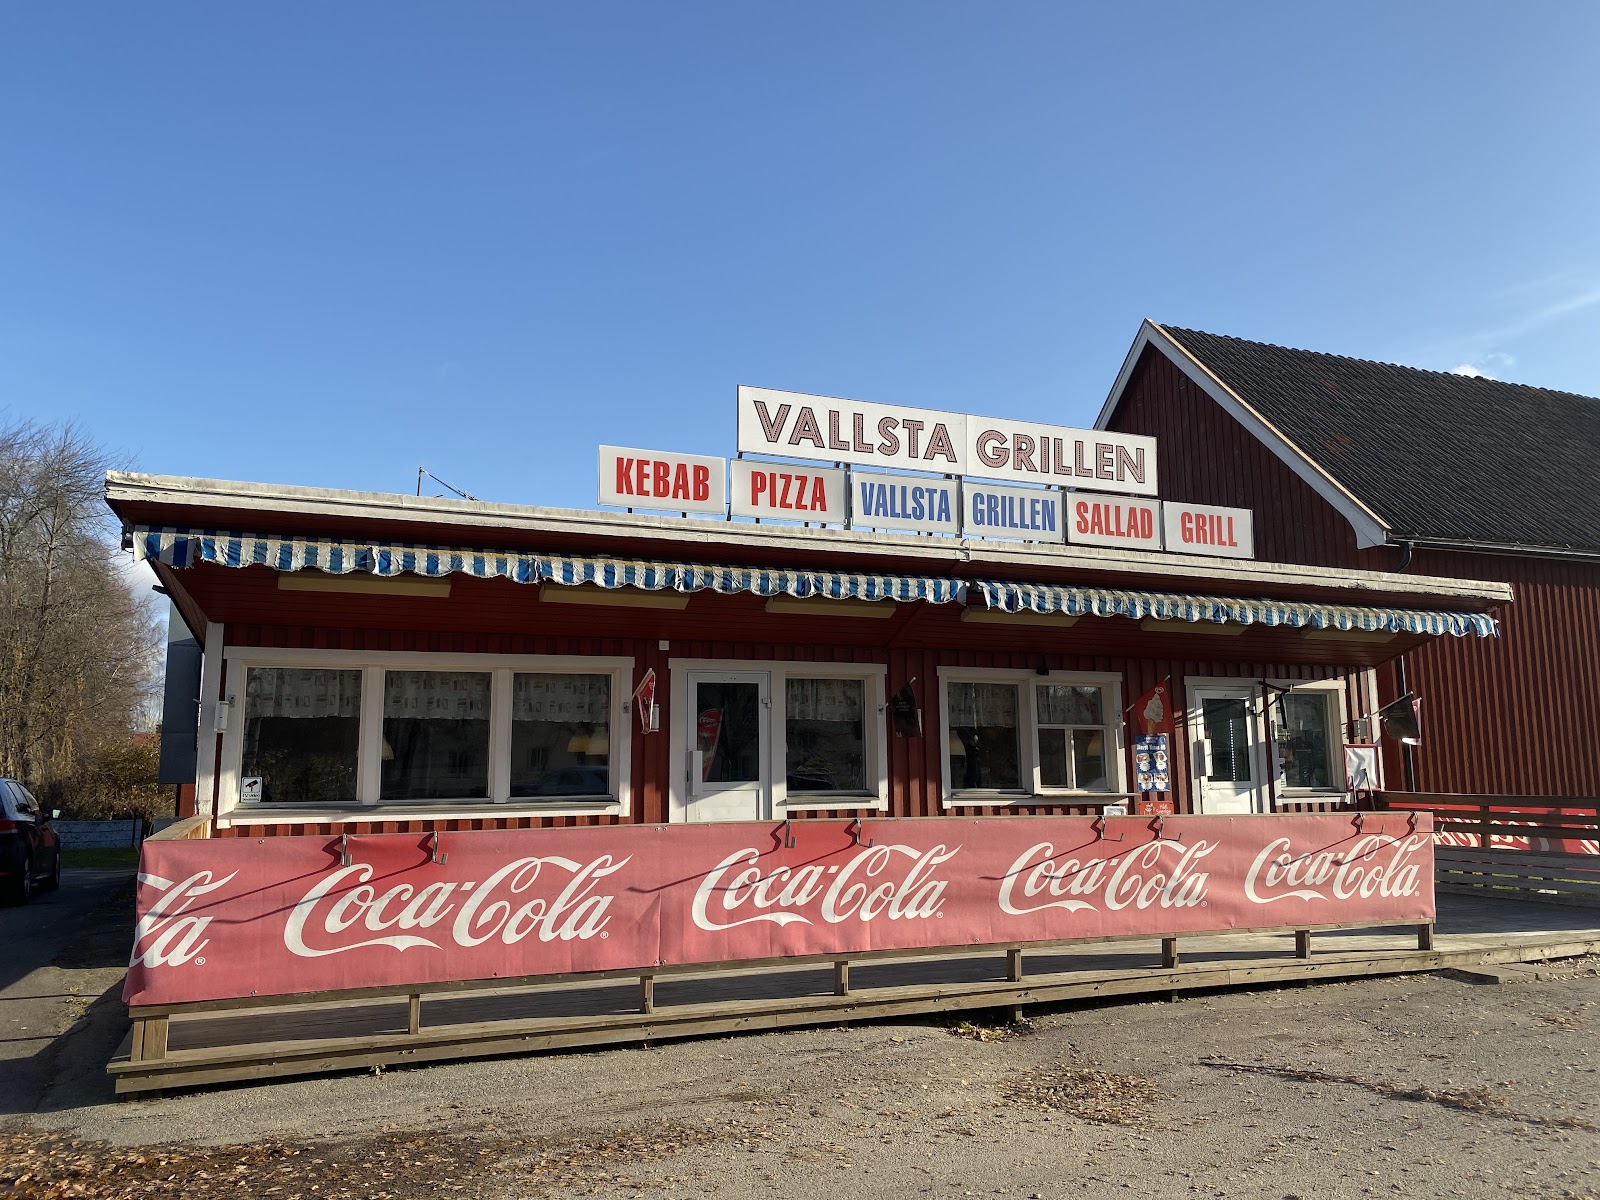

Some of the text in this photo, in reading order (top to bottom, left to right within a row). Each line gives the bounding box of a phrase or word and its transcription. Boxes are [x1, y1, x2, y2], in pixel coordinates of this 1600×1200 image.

[753, 399, 1145, 484] VALLSTA GRILLEN
[616, 456, 709, 501] KEBAB
[751, 470, 827, 512] PIZZA
[860, 481, 951, 522] VALLSTA
[972, 492, 1056, 532] GRILLEN
[1076, 501, 1153, 539] SALLAD
[1180, 511, 1238, 547] GRILL
[691, 843, 963, 931] Coca-Cola
[998, 839, 1221, 915] Coca-Cola
[1244, 834, 1430, 904] Coca-Cola
[284, 852, 634, 958] Coca-Cola
